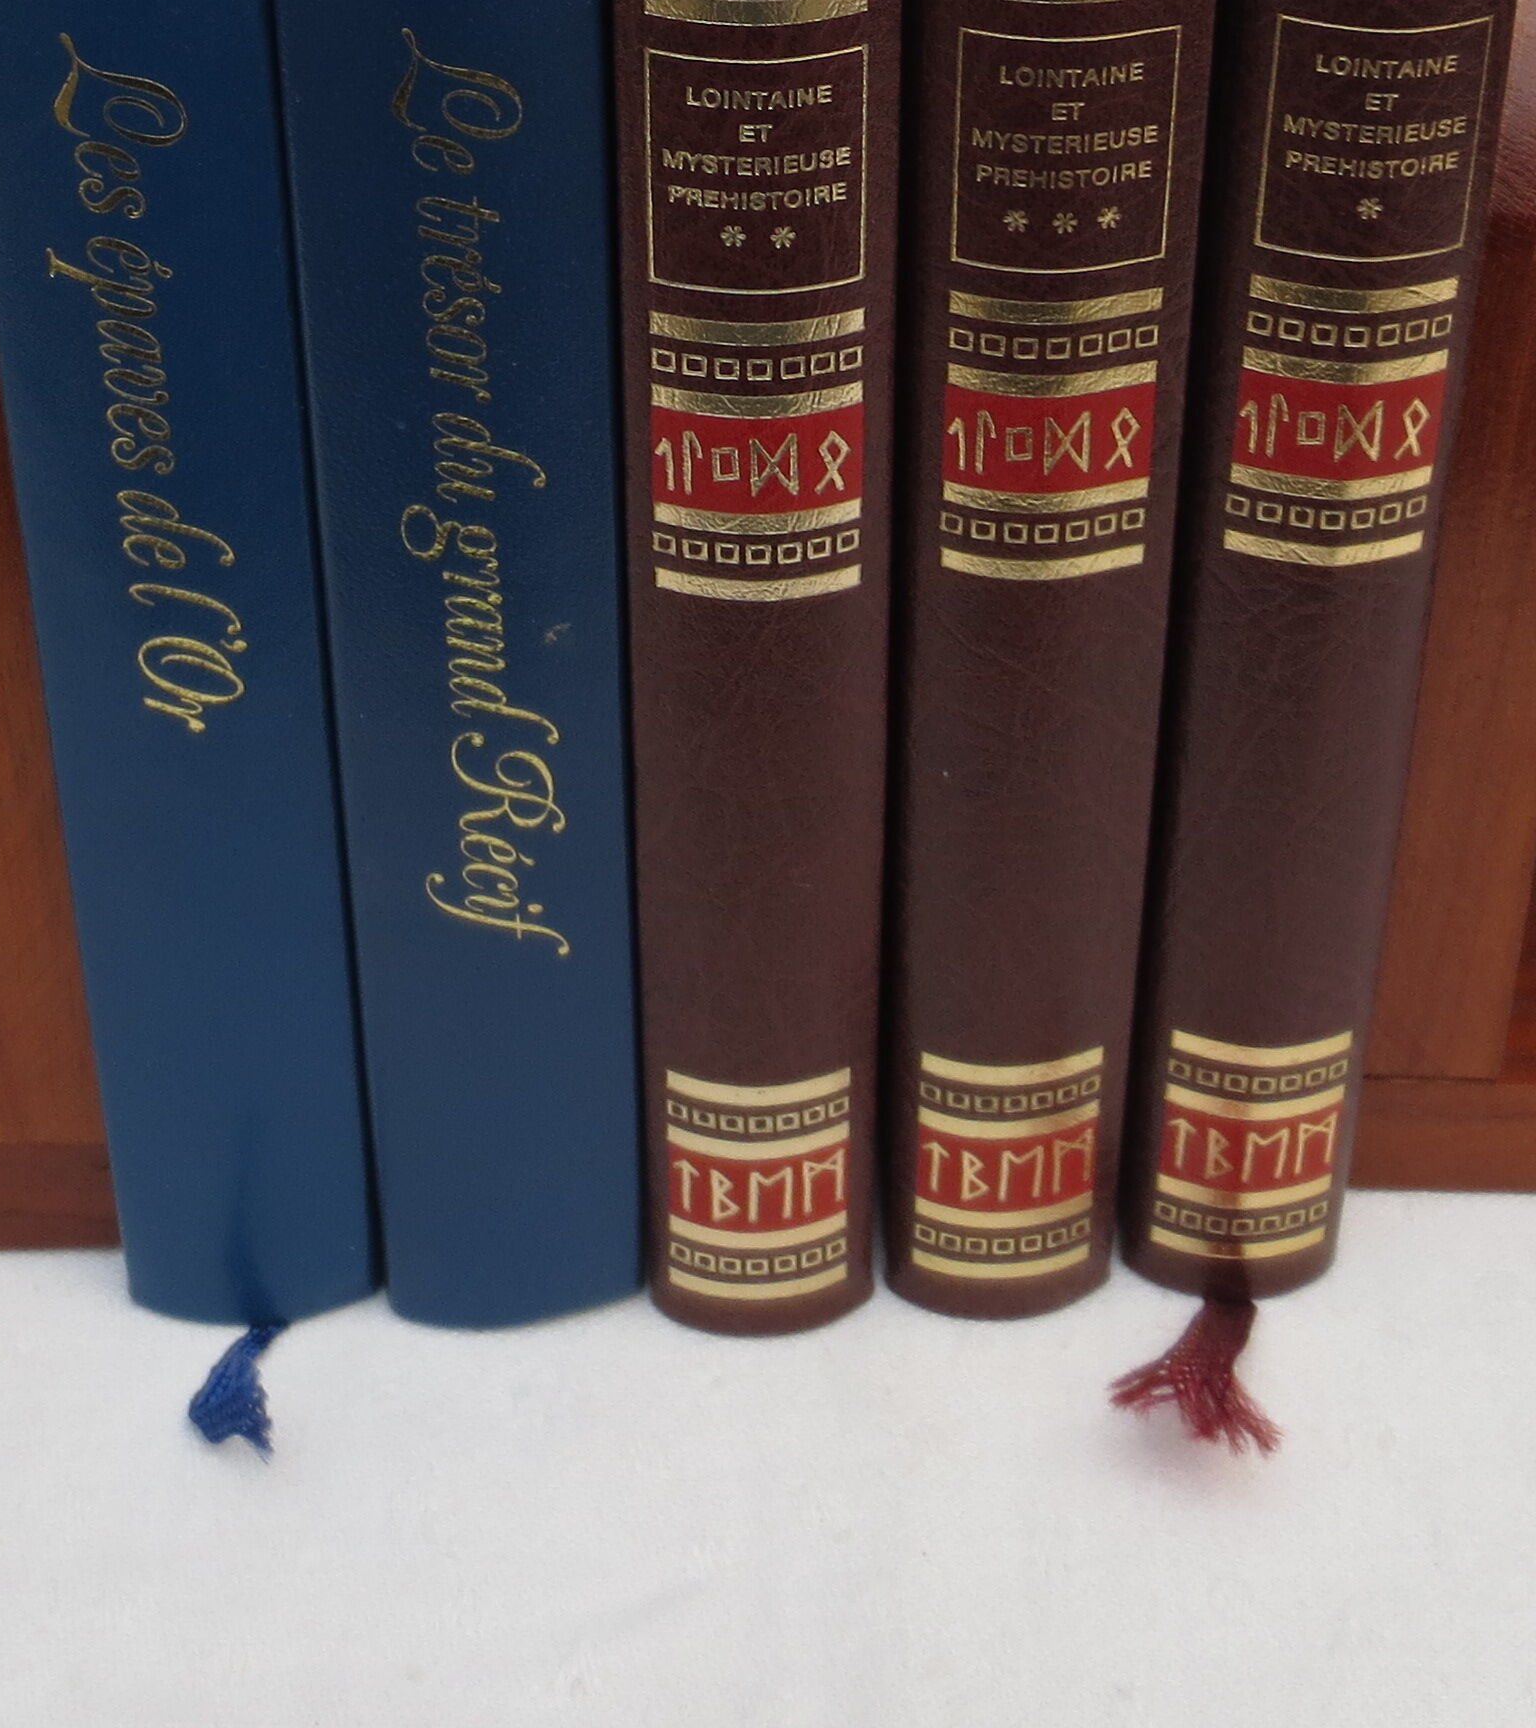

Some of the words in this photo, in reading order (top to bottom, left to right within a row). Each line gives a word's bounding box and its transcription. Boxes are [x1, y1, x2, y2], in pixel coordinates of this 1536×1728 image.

[999, 62, 1145, 89] LOINTAINE
[1315, 54, 1460, 79] LOINTAINE
[391, 27, 523, 174] Le
[686, 84, 833, 111] LOINTAINE
[1051, 102, 1086, 121] ET
[1364, 92, 1399, 112] ET
[52, 31, 188, 219] Les
[738, 124, 773, 143] ET
[971, 125, 1159, 155] MYSTERIEUSE
[1282, 113, 1467, 145] MYSTERIEUSE
[662, 146, 852, 177] MYSTERIEUSE
[975, 160, 1152, 189] PREHISTOIRE
[1284, 149, 1461, 179] PREHISTOIRE
[667, 181, 848, 211] PREHISTOIRE
[415, 194, 503, 403] trésor
[431, 411, 547, 504] du
[115, 488, 236, 569] de
[400, 504, 560, 745] grand
[426, 730, 571, 957] Récif
